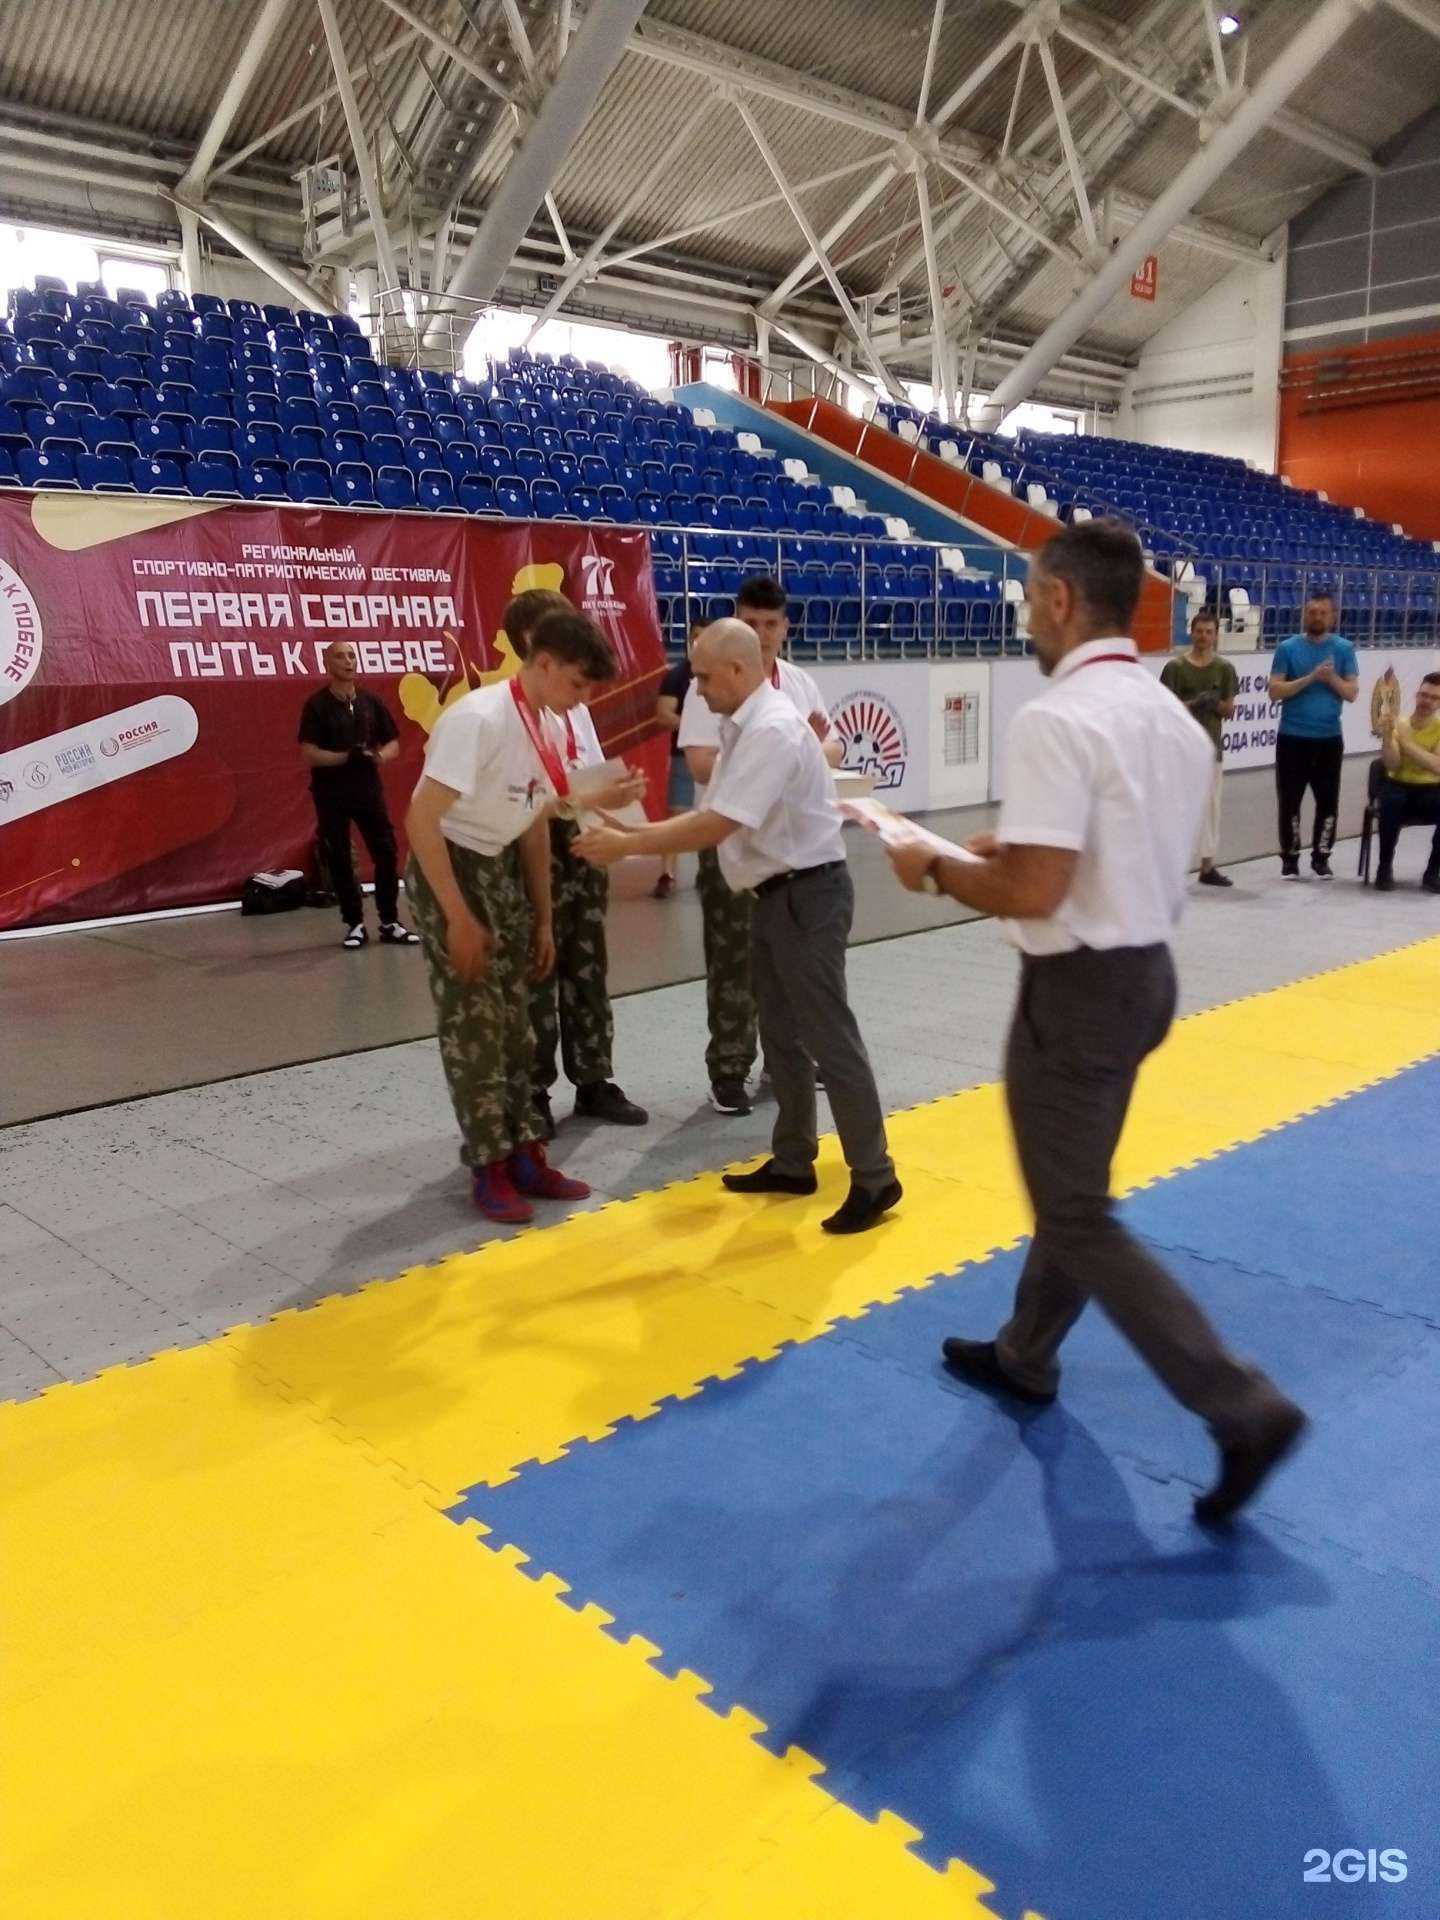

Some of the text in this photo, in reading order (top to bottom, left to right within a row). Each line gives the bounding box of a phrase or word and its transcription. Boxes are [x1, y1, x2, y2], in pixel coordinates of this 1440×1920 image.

[241, 544, 356, 562] РЕГИОНАЛЬНЫЙ
[132, 559, 451, 583] СПОРТИВНО-ПАТРИОТИЧЕСКИЙ ФЕСТИВАЛЬ
[136, 590, 465, 628] ПЕРВАЯ СБОРНАЯ.
[4, 602, 35, 683] ПОБЕДЕ
[169, 640, 455, 678] ПУТЬ К ПБЕДЕ.
[118, 720, 158, 742] РОССИЯ
[1222, 729, 1277, 753] ОДА НОВ
[54, 743, 93, 767] РОССИЯ
